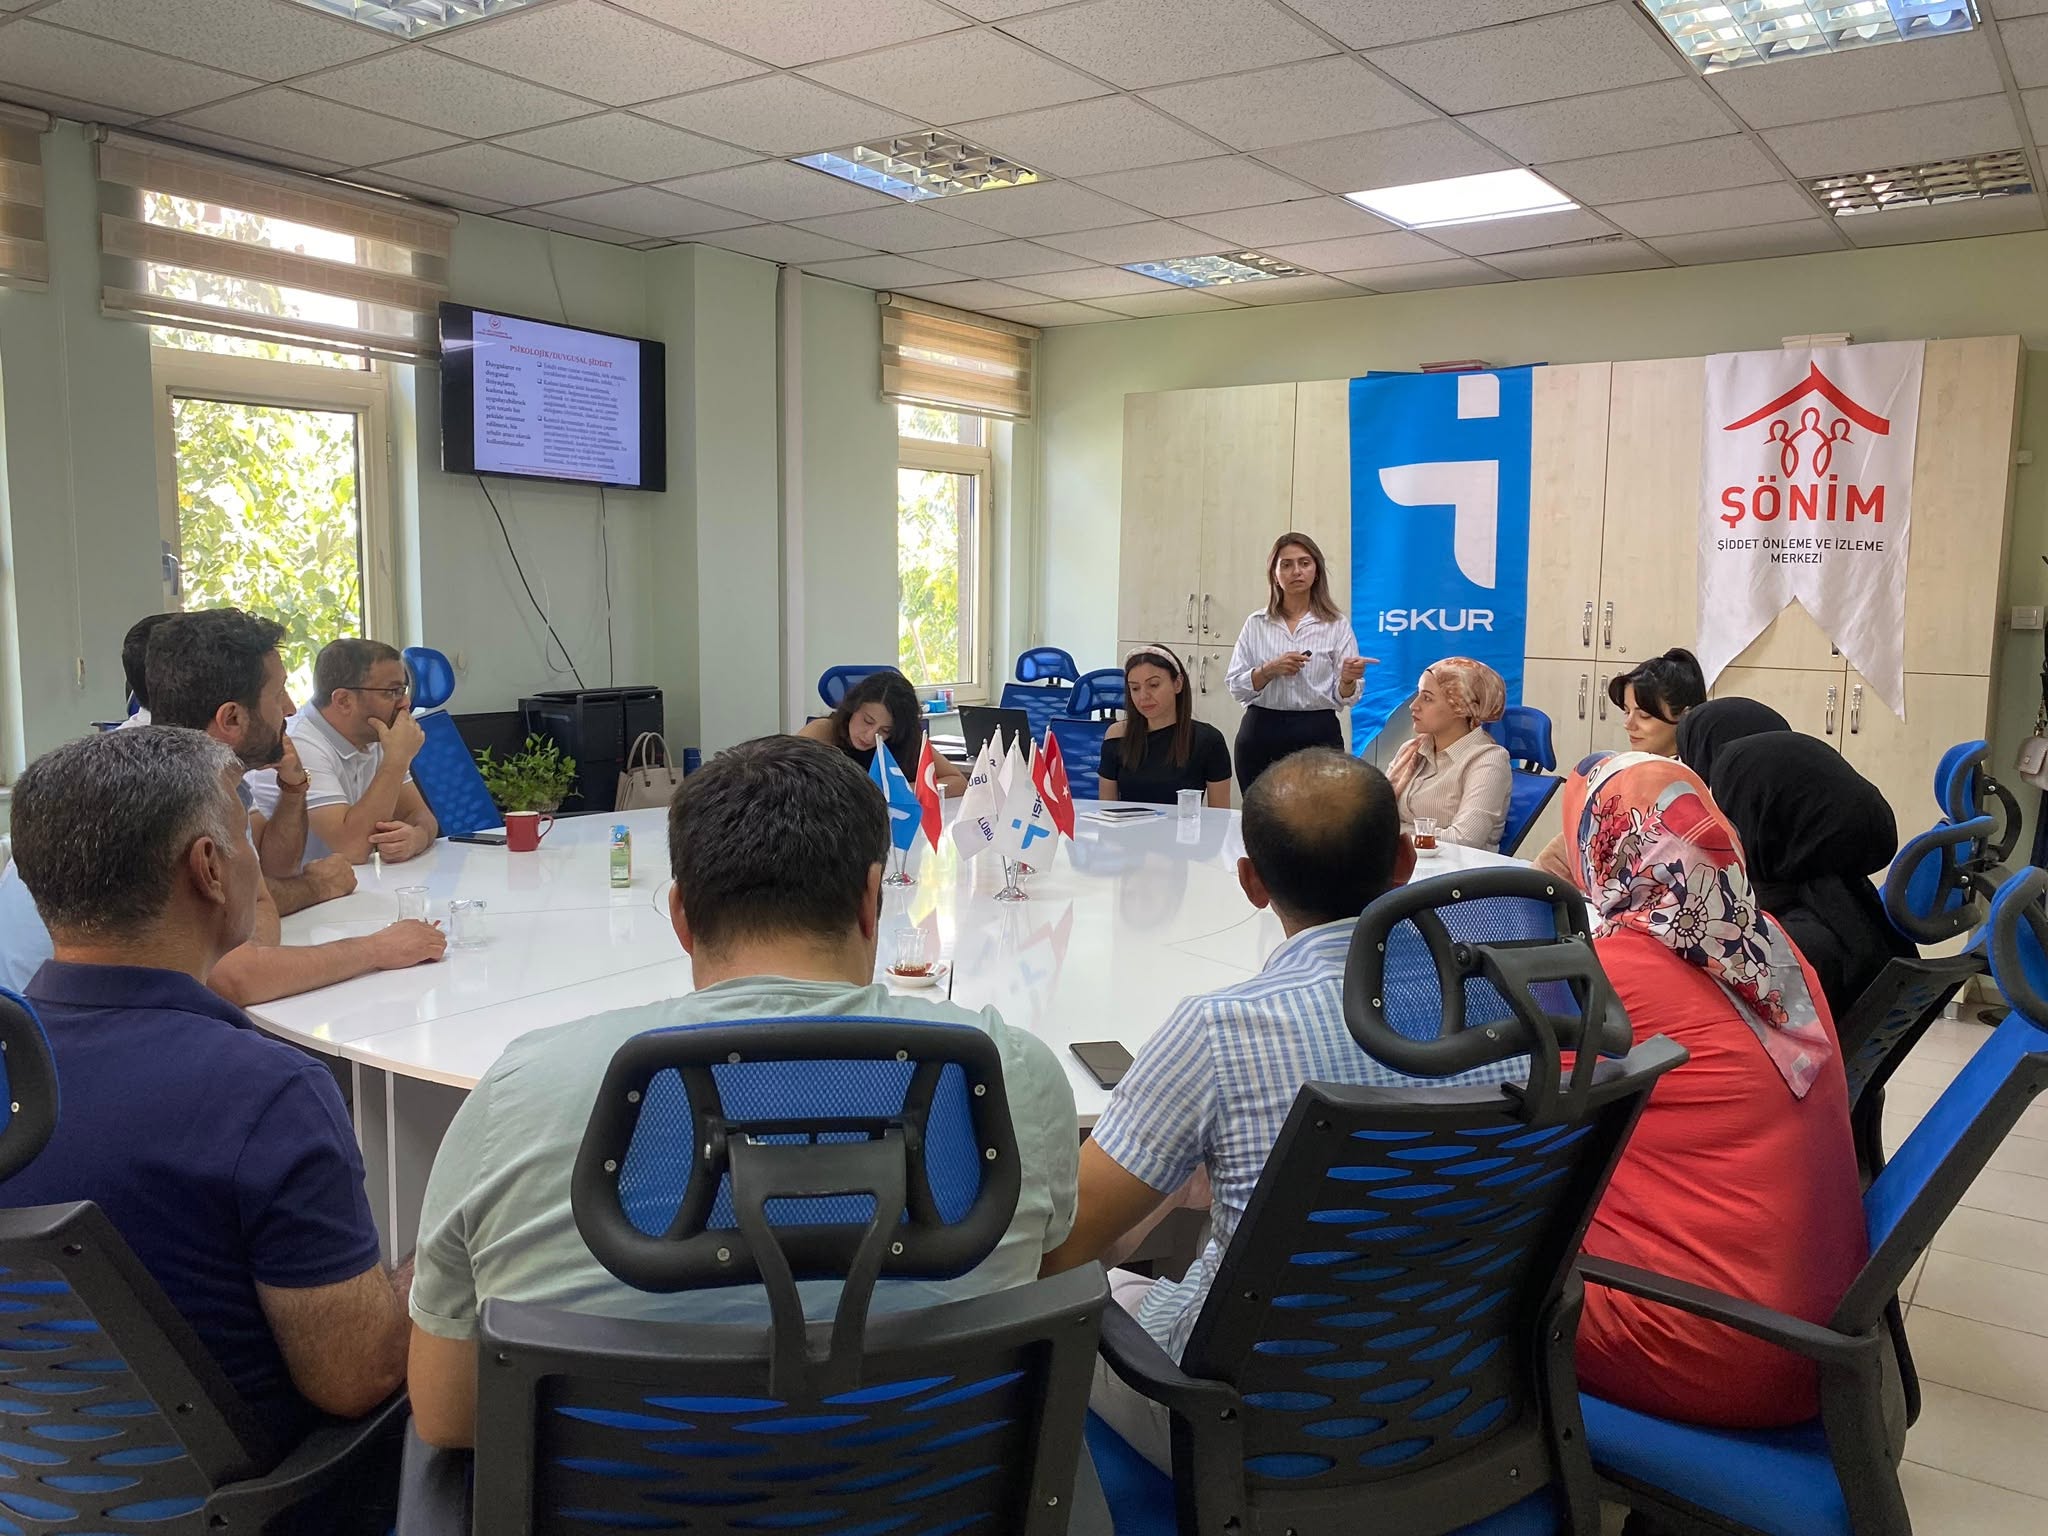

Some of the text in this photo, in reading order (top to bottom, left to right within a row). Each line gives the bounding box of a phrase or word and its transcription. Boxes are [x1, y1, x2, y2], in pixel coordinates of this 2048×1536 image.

[1720, 474, 1885, 529] ŞÖNİM
[1717, 537, 1884, 551] ŞİDDET ÖNLEME VE İZLEME
[1770, 552, 1823, 564] MERKEZİ
